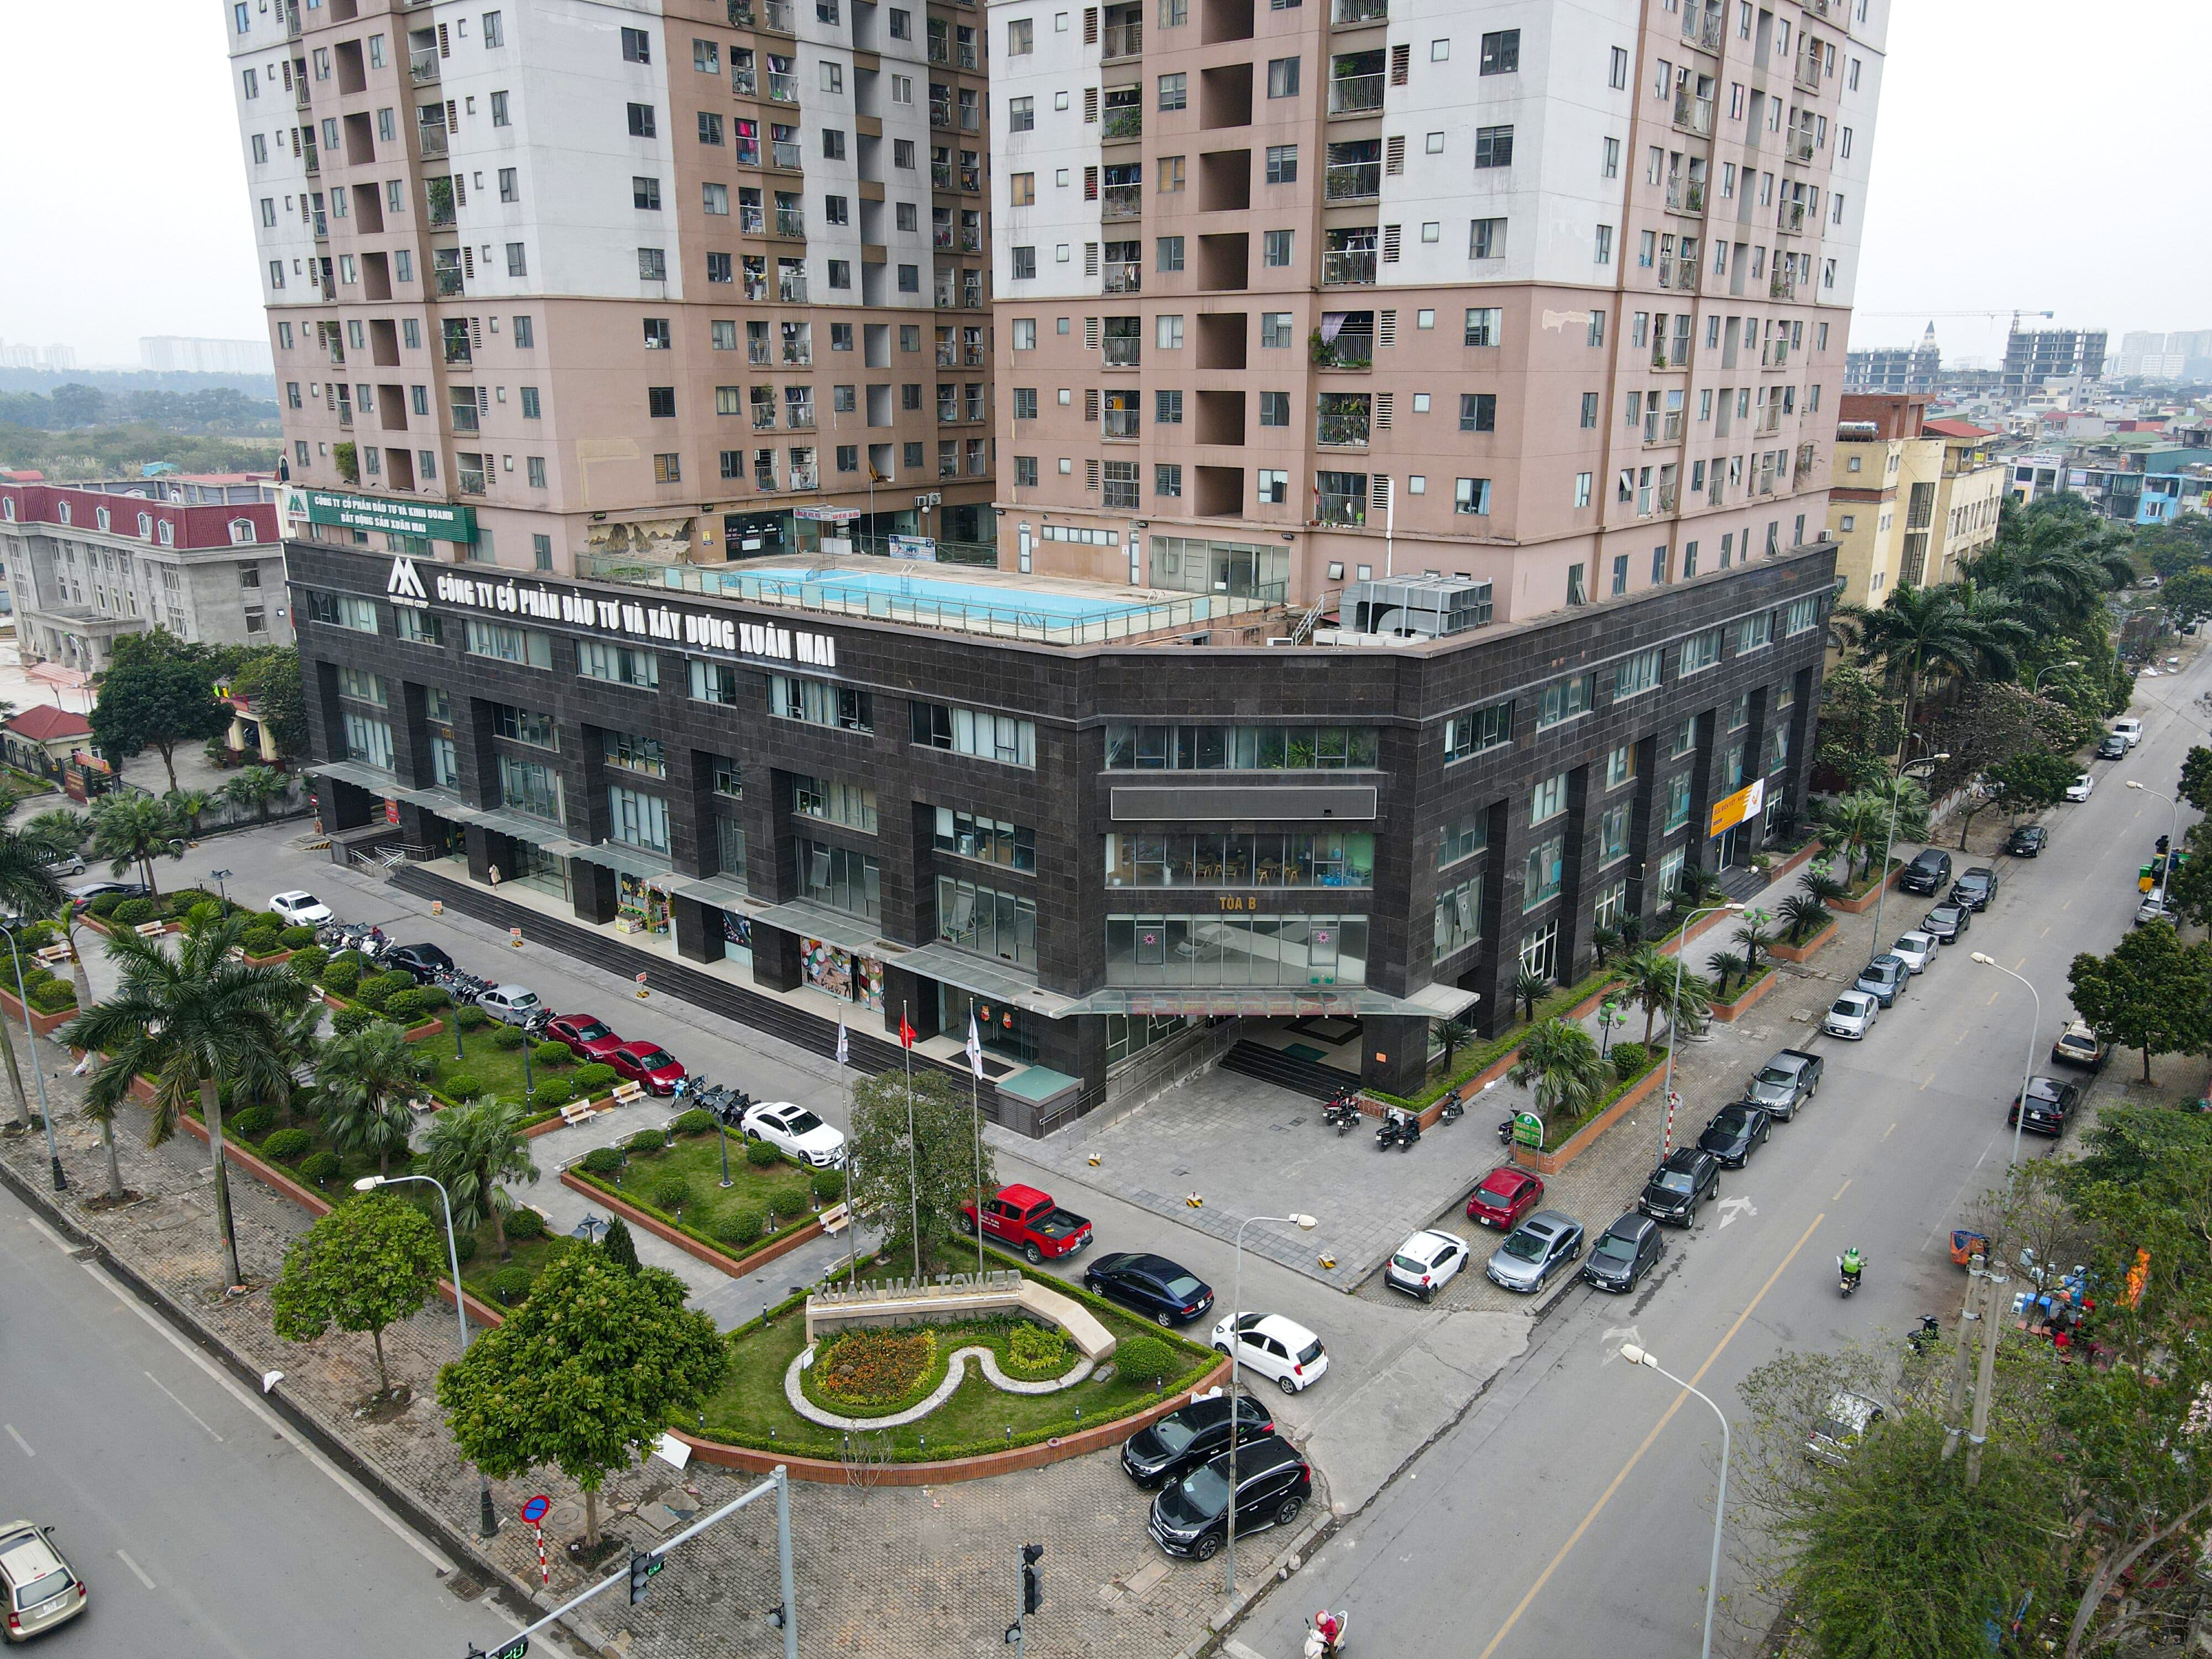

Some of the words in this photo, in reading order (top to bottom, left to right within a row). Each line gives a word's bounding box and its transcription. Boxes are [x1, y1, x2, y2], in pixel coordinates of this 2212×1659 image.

[333, 499, 340, 508] TY
[427, 509, 453, 520] DOANH
[411, 523, 426, 533] MAI
[437, 572, 476, 606] CÔNG
[476, 582, 494, 608] TY
[496, 578, 517, 613] CỔ
[519, 582, 560, 619] PHẦN
[562, 588, 595, 626] ĐẦU
[597, 599, 620, 630] TƯ
[622, 602, 646, 634] VÀ
[648, 606, 681, 640] XÂY
[685, 614, 735, 651] DỰNG
[739, 622, 791, 659] XUÂN
[796, 632, 836, 667] MAI
[1219, 894, 1243, 910] TÒA
[1248, 897, 1256, 910] B
[810, 1279, 878, 1305] XUAN
[885, 1275, 928, 1300] MAI
[935, 1269, 1025, 1296] TOWER
